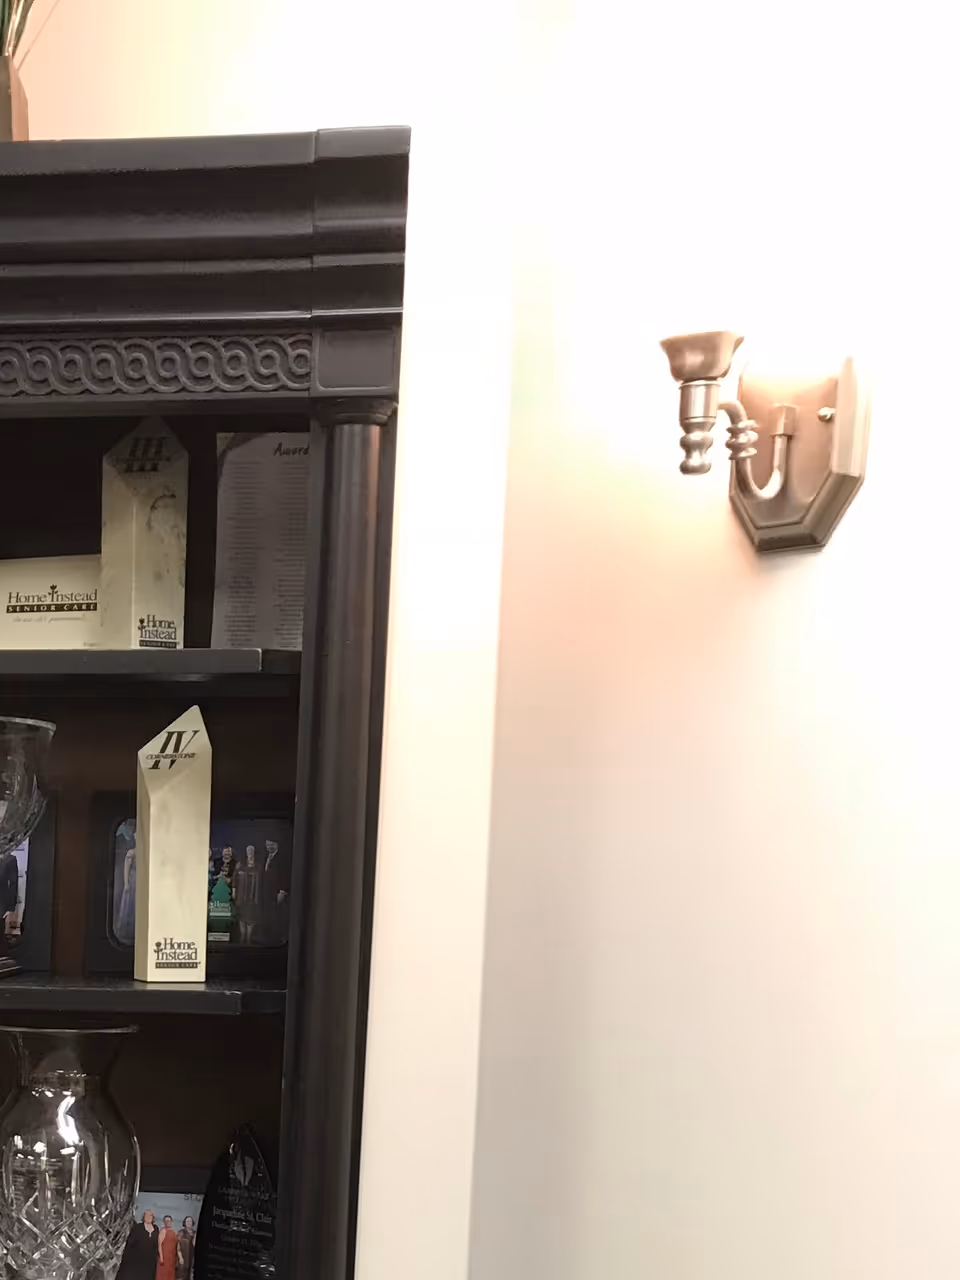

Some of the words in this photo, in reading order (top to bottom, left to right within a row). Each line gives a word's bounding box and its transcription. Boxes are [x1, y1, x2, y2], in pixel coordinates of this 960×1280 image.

[8, 592, 47, 603] Home
[49, 588, 97, 602] Instead
[63, 603, 96, 611] CARE
[147, 615, 175, 629] Home
[140, 626, 177, 640] Instead
[148, 730, 200, 770] IV
[163, 937, 196, 951] Home
[155, 949, 198, 961] Instead
